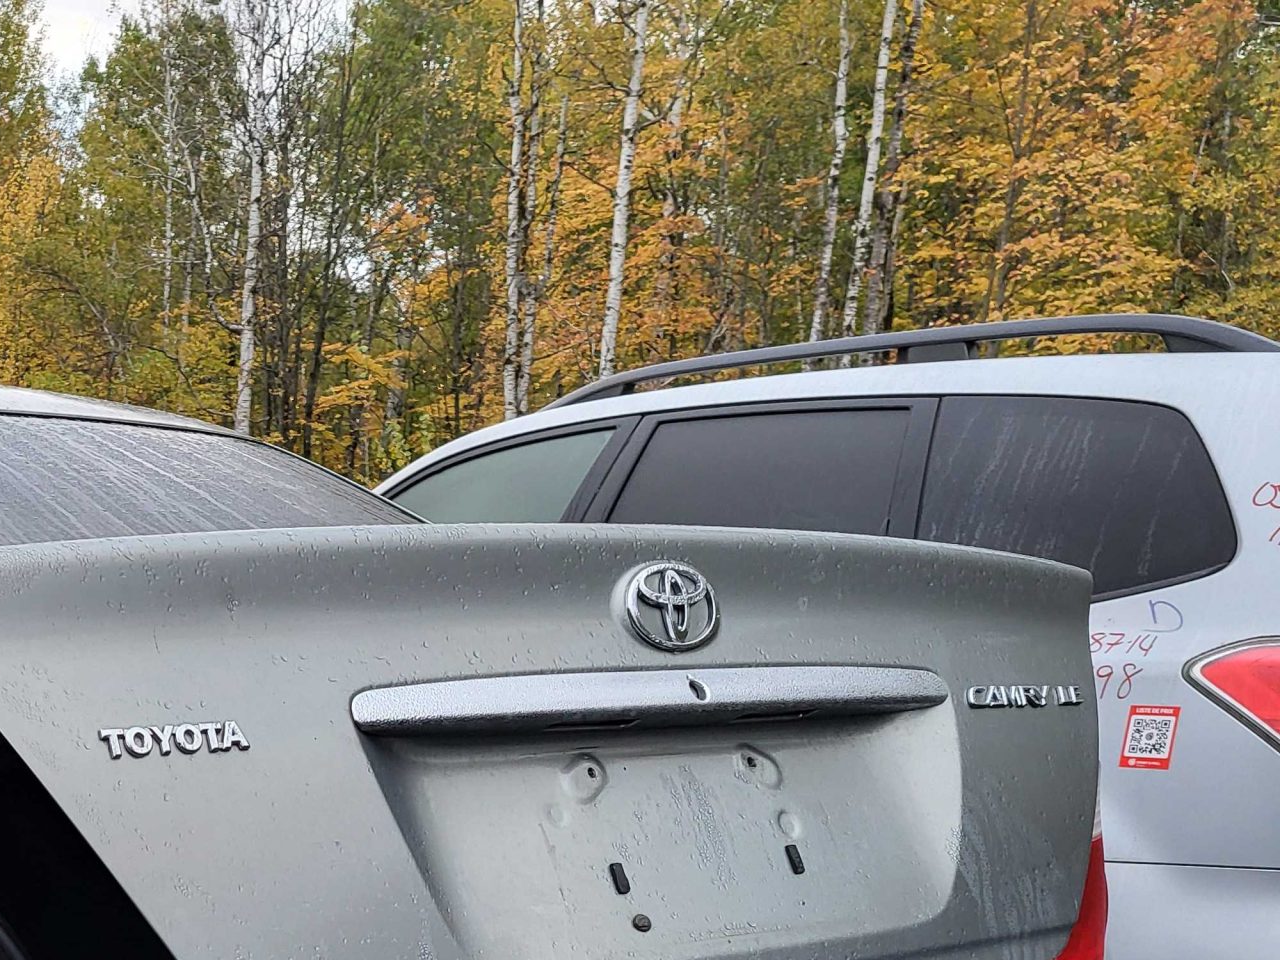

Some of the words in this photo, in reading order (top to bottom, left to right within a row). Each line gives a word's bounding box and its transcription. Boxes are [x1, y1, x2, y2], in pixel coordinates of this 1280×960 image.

[966, 684, 1049, 709] CAMRY
[1053, 685, 1084, 706] LE
[98, 720, 250, 760] TOYOTA
